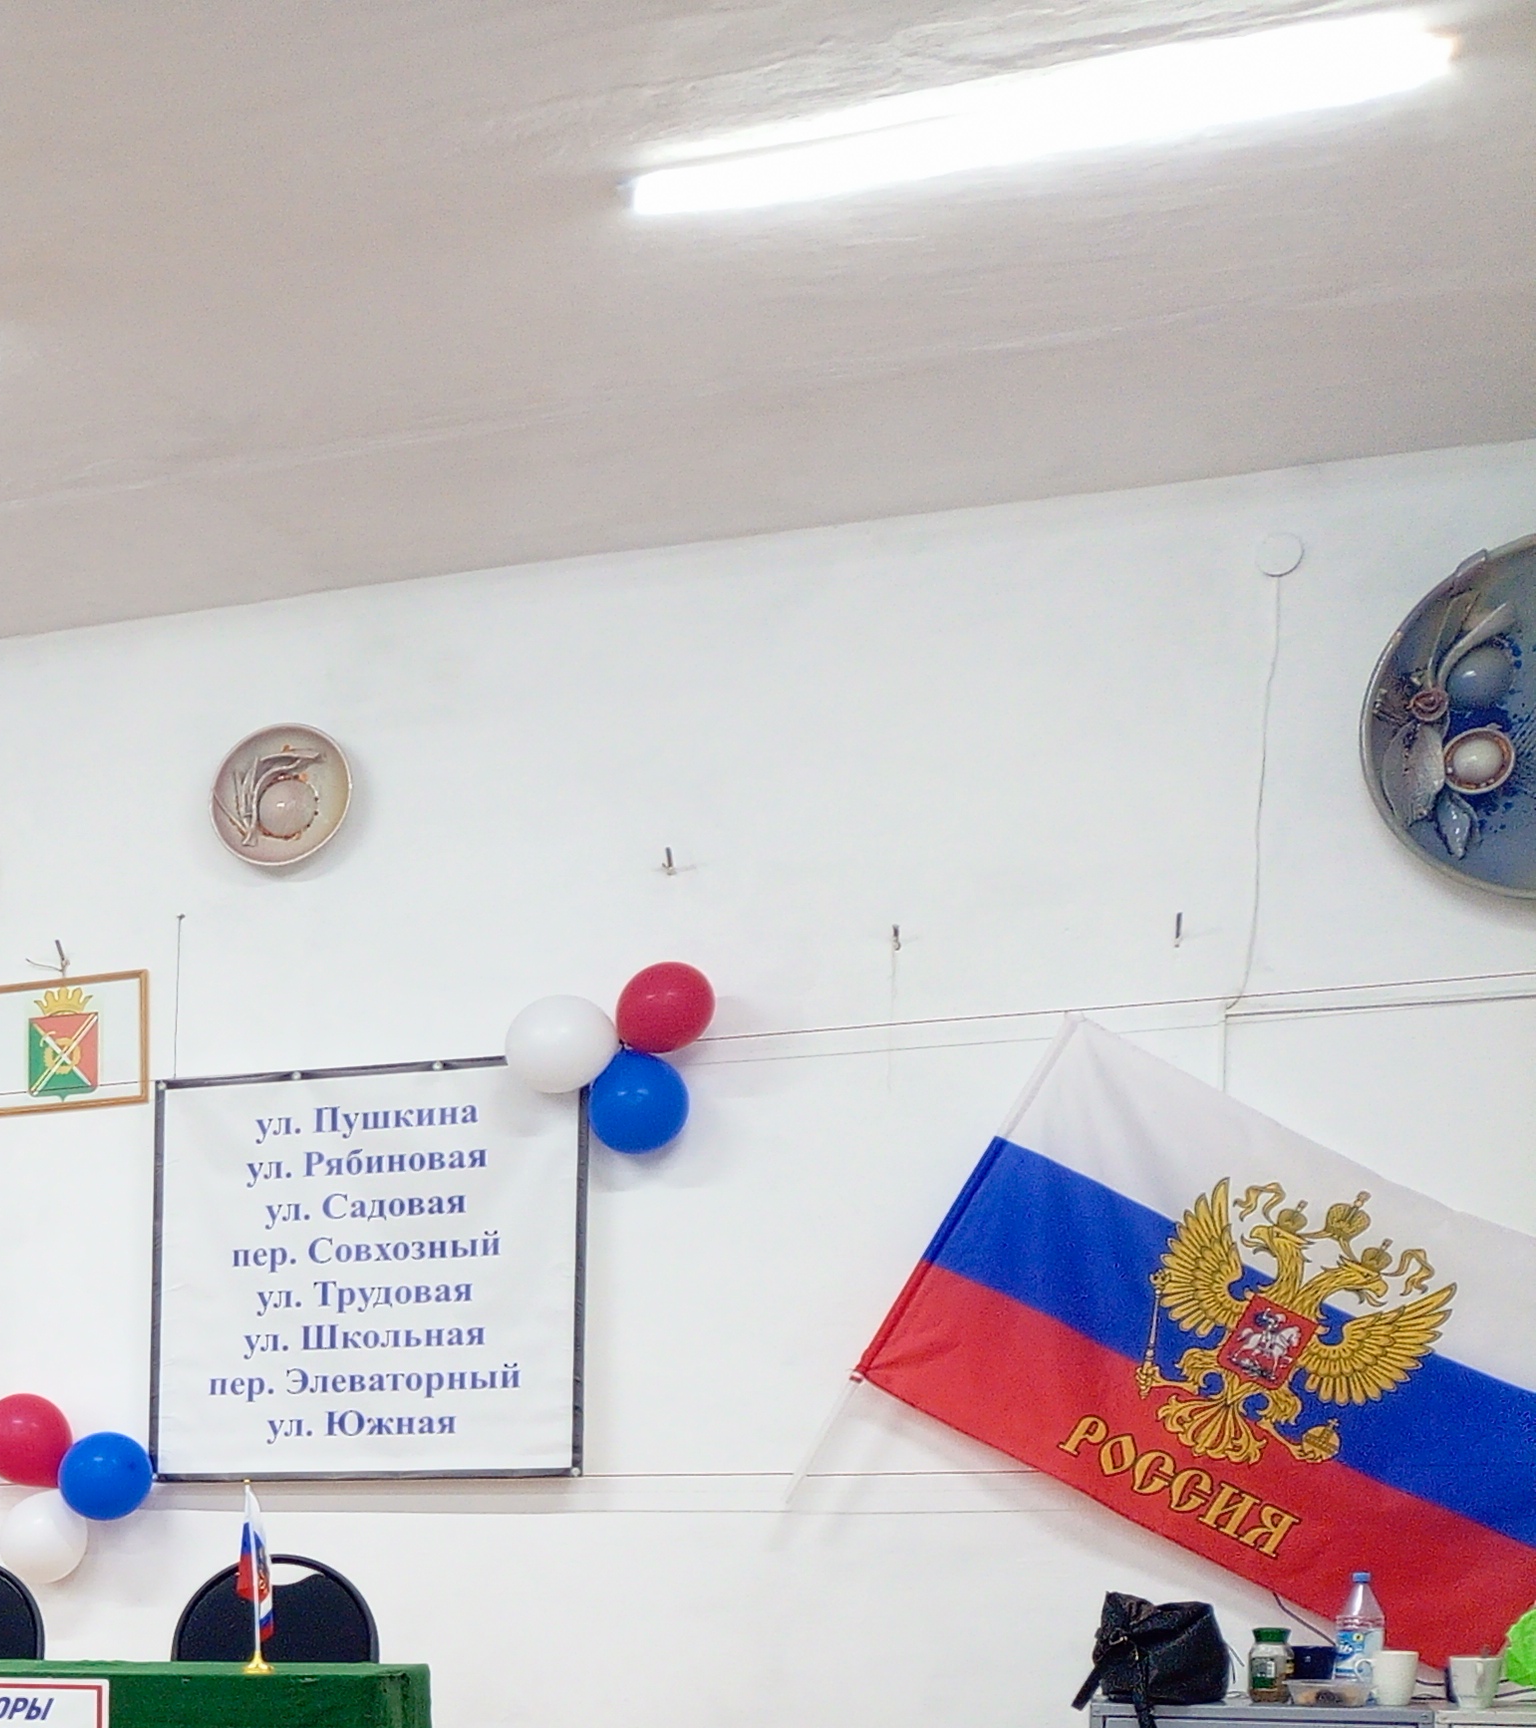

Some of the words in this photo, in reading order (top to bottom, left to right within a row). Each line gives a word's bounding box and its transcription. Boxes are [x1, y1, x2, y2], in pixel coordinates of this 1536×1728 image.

[256, 1118, 300, 1144] ул.
[316, 1105, 477, 1138] Пушкина
[247, 1162, 291, 1187] ул.
[306, 1149, 486, 1176] Рябиновая
[265, 1204, 310, 1229] ул.
[323, 1194, 465, 1221] Садовая
[234, 1248, 296, 1273] пер.
[309, 1230, 499, 1263] Совхозный
[257, 1291, 301, 1316] ул.
[314, 1281, 472, 1313] Трудовая
[244, 1334, 288, 1359] ул.
[303, 1325, 484, 1350] Школьная
[210, 1378, 274, 1402] пер.
[287, 1363, 519, 1398] Элеваторный
[267, 1419, 312, 1444] ул.
[327, 1410, 454, 1436] Южная
[1058, 1415, 1301, 1559] РОССИЯ
